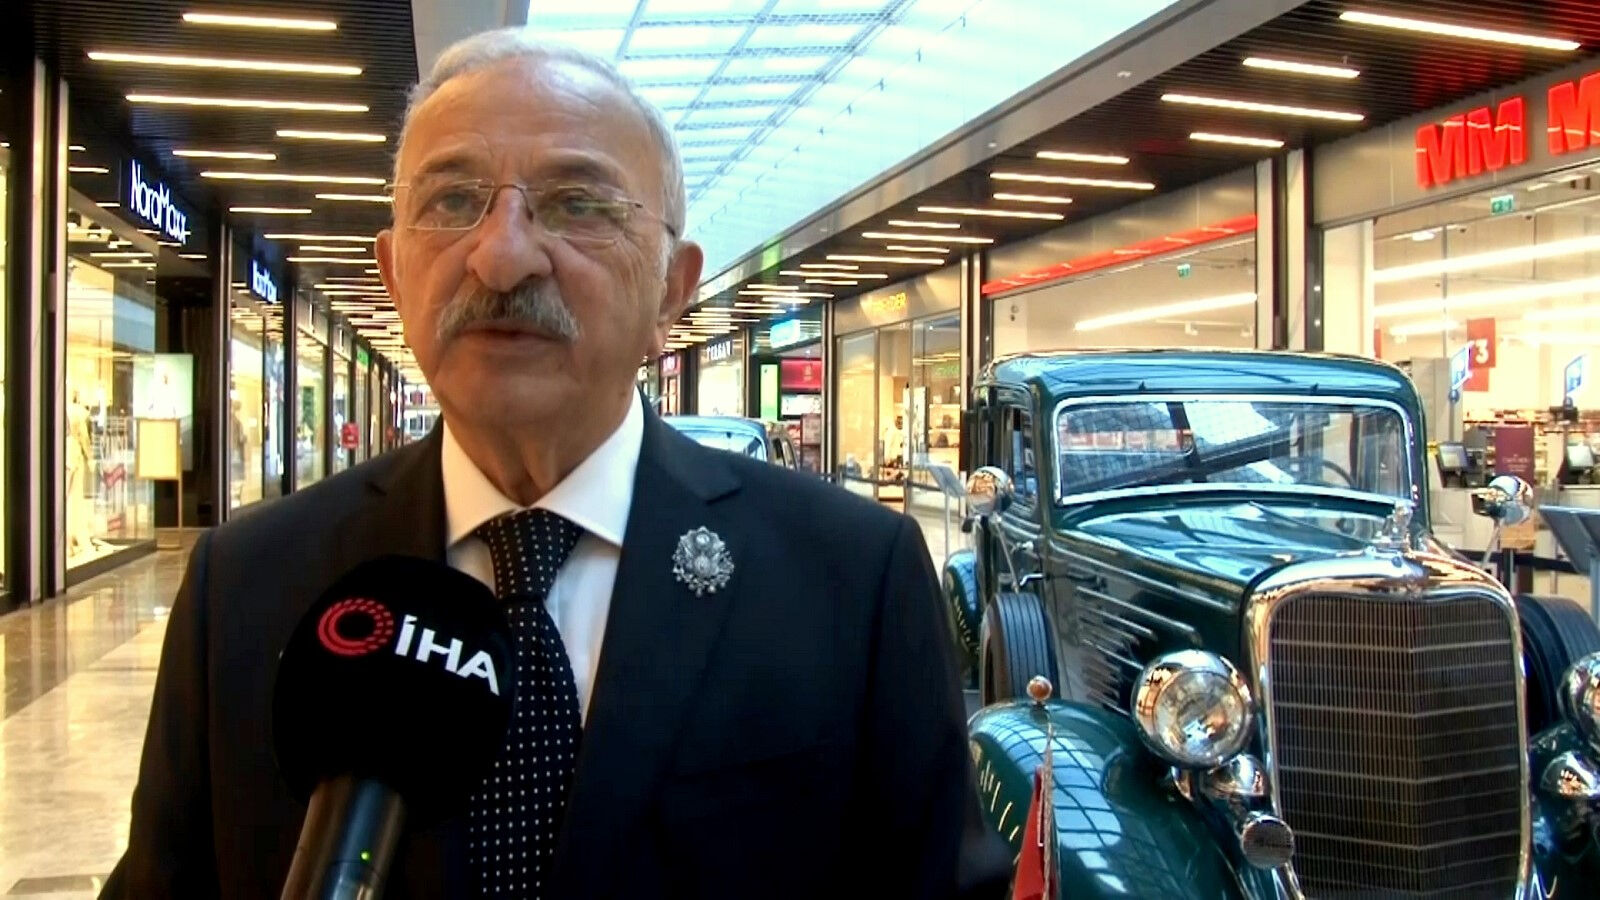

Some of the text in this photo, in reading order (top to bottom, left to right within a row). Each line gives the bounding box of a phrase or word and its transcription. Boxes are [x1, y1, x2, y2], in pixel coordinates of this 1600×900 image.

[1415, 97, 1526, 188] MM
[131, 159, 187, 245] NaraMaxx
[1475, 338, 1489, 364] 3
[395, 614, 499, 696] İHA
